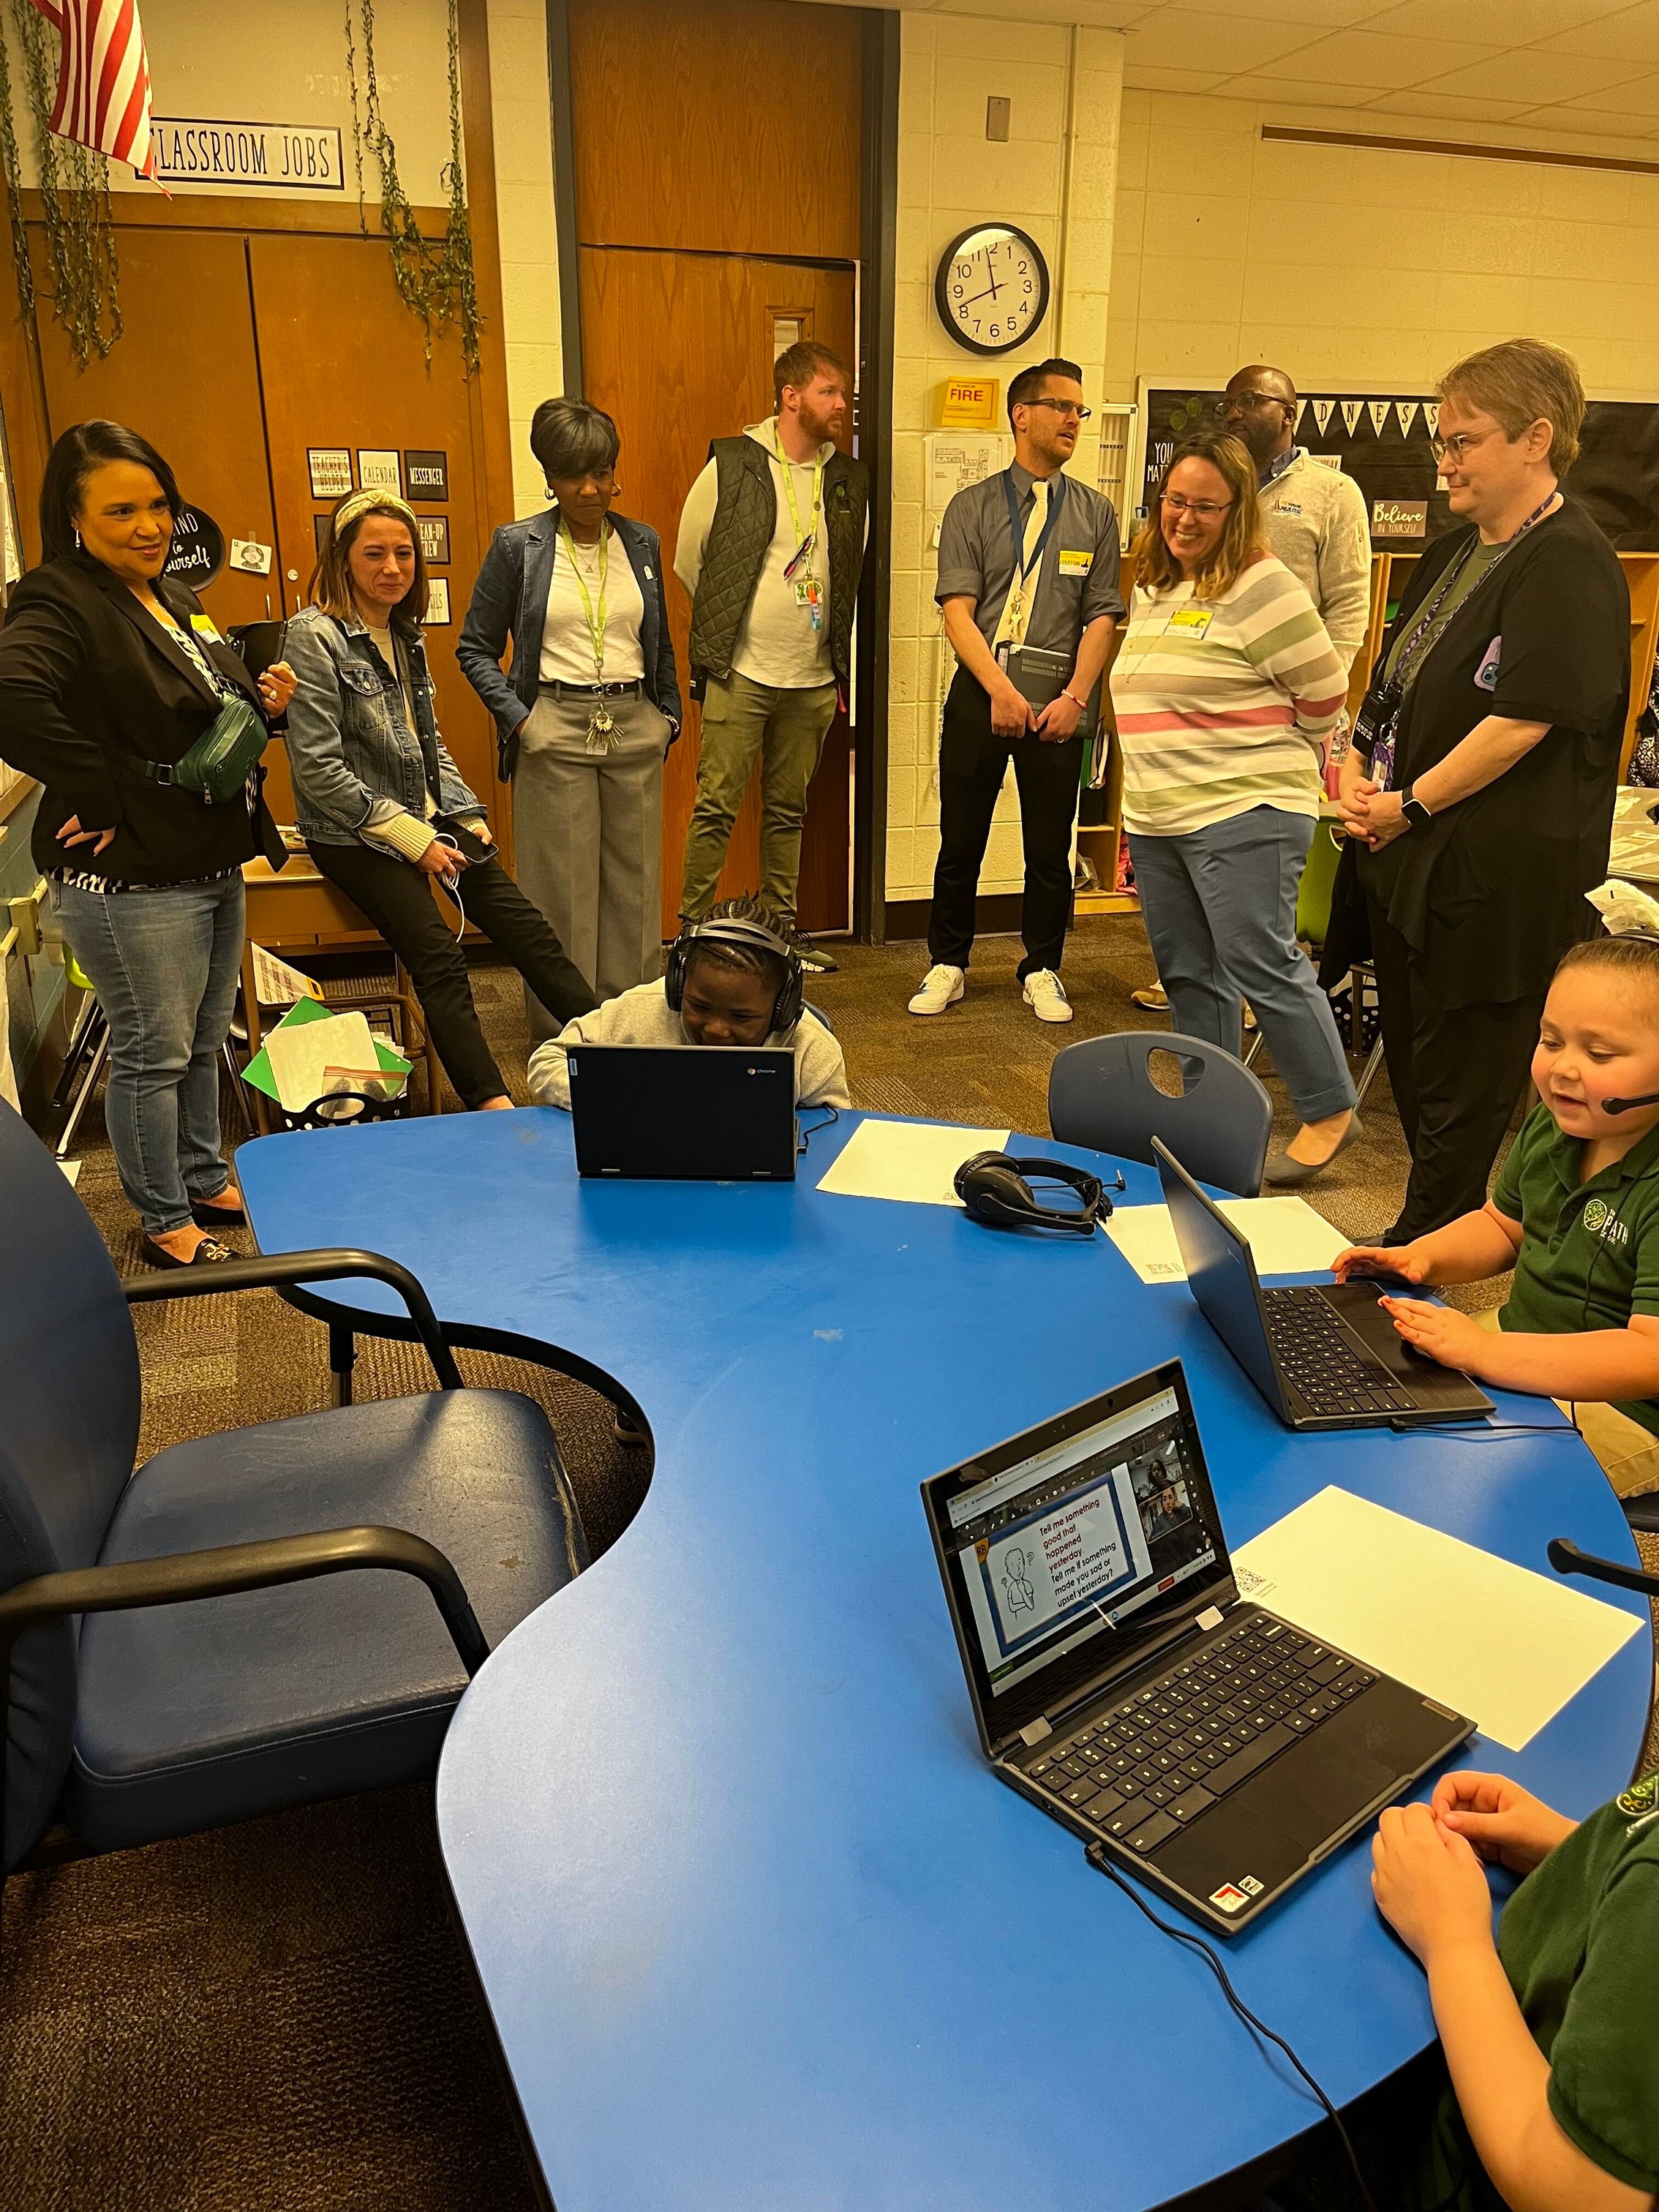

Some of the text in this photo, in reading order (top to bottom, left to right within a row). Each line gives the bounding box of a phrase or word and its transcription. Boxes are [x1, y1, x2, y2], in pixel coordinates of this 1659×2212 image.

[281, 135, 329, 178] JOBS
[1007, 245, 1012, 260] 1
[956, 264, 971, 279] 10
[1017, 260, 1027, 275] 2
[953, 285, 963, 298] 9
[1023, 279, 1032, 293] 3
[959, 305, 968, 319] 8
[1019, 301, 1028, 314] 4
[972, 320, 982, 334] 7
[990, 323, 1000, 337] 6
[1007, 317, 1017, 331] 5
[950, 388, 984, 402] FIRE
[1155, 443, 1173, 464] YOU
[364, 466, 397, 484] CALENDAR
[409, 467, 444, 486] MESSENGER
[1374, 503, 1424, 524] Believe
[173, 513, 198, 537] IND
[418, 523, 444, 541] EAN-UP
[1377, 523, 1417, 534] IN YOURSELF
[1602, 1215, 1629, 1245] PATH
[1039, 1500, 1100, 1536] Tell me something
[1043, 1524, 1076, 1549] good that
[977, 1544, 987, 1557] RB
[1046, 1534, 1082, 1560] happened
[1051, 1542, 1116, 1584] Tell me if something
[1054, 1558, 1111, 1596] made you sad or
[1057, 1568, 1113, 1608] upset yesterday?
